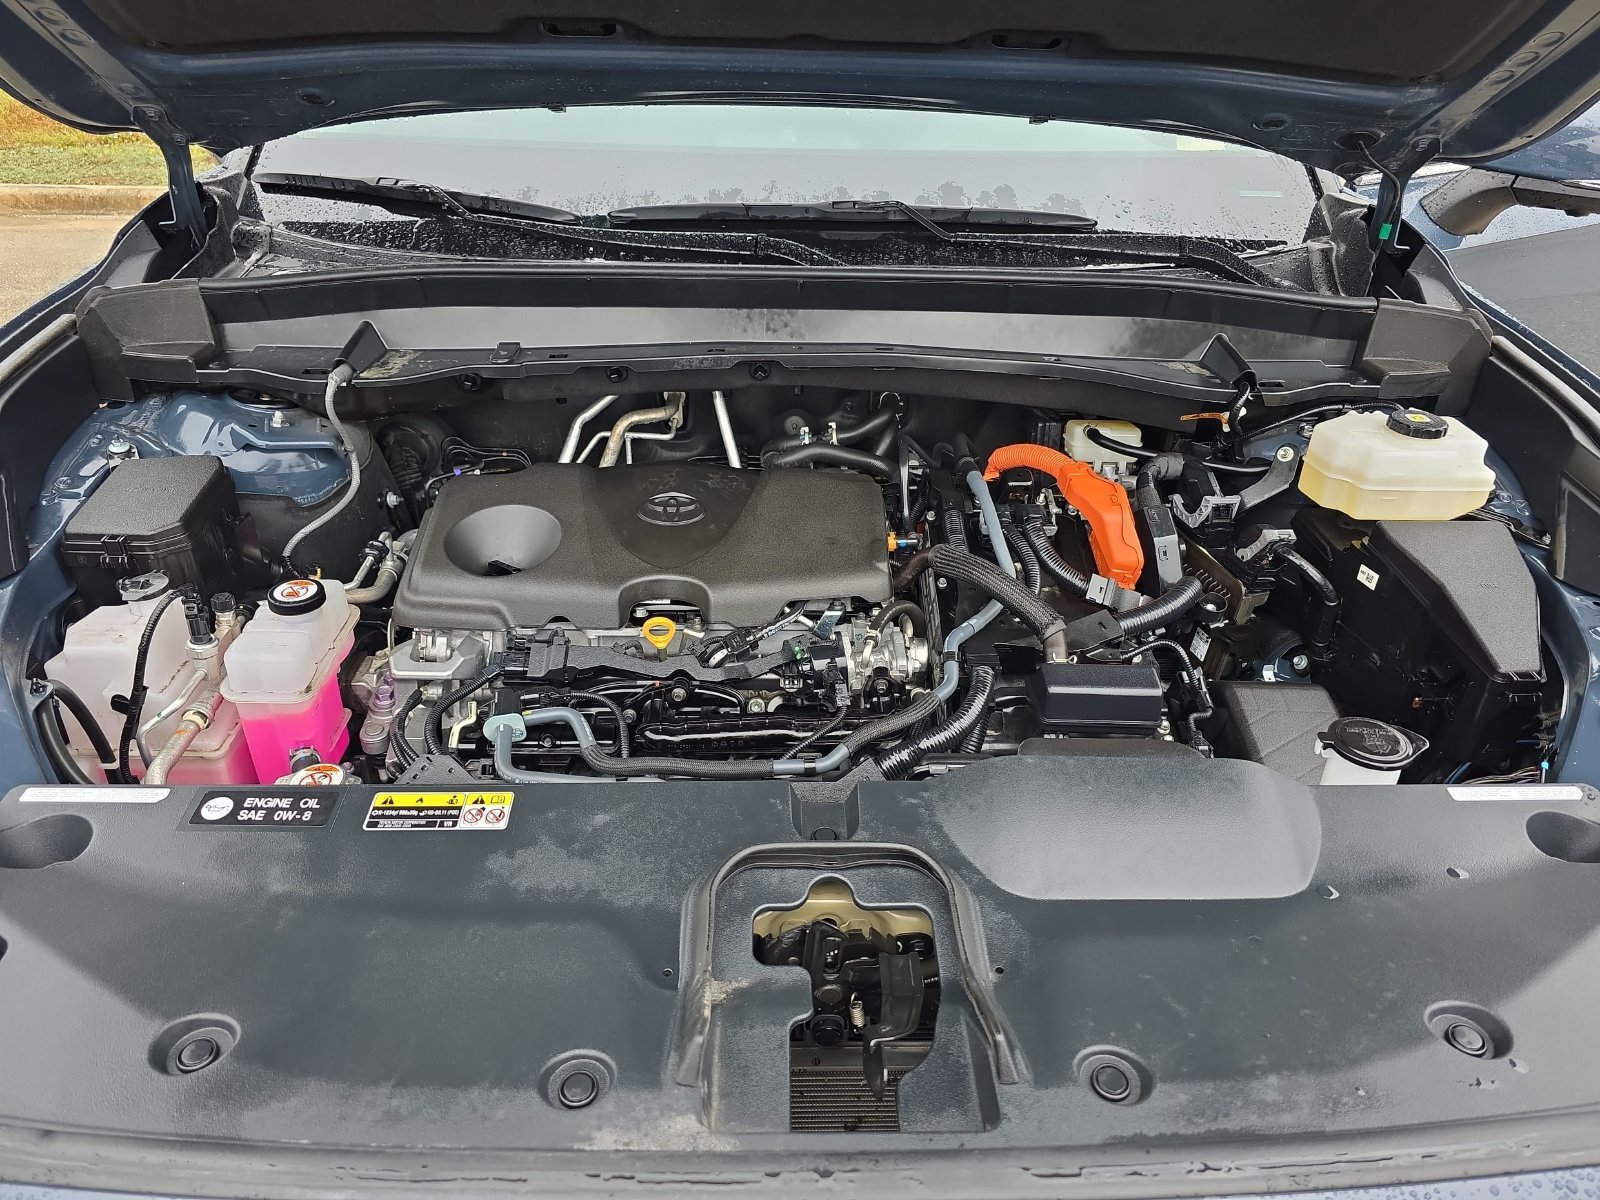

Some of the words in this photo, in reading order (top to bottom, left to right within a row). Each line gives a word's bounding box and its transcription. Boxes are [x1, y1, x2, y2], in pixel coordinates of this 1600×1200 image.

[243, 797, 293, 808] ENGINE
[299, 798, 320, 809] OIL
[237, 810, 266, 821] SAE
[273, 810, 312, 821] 0W-8
